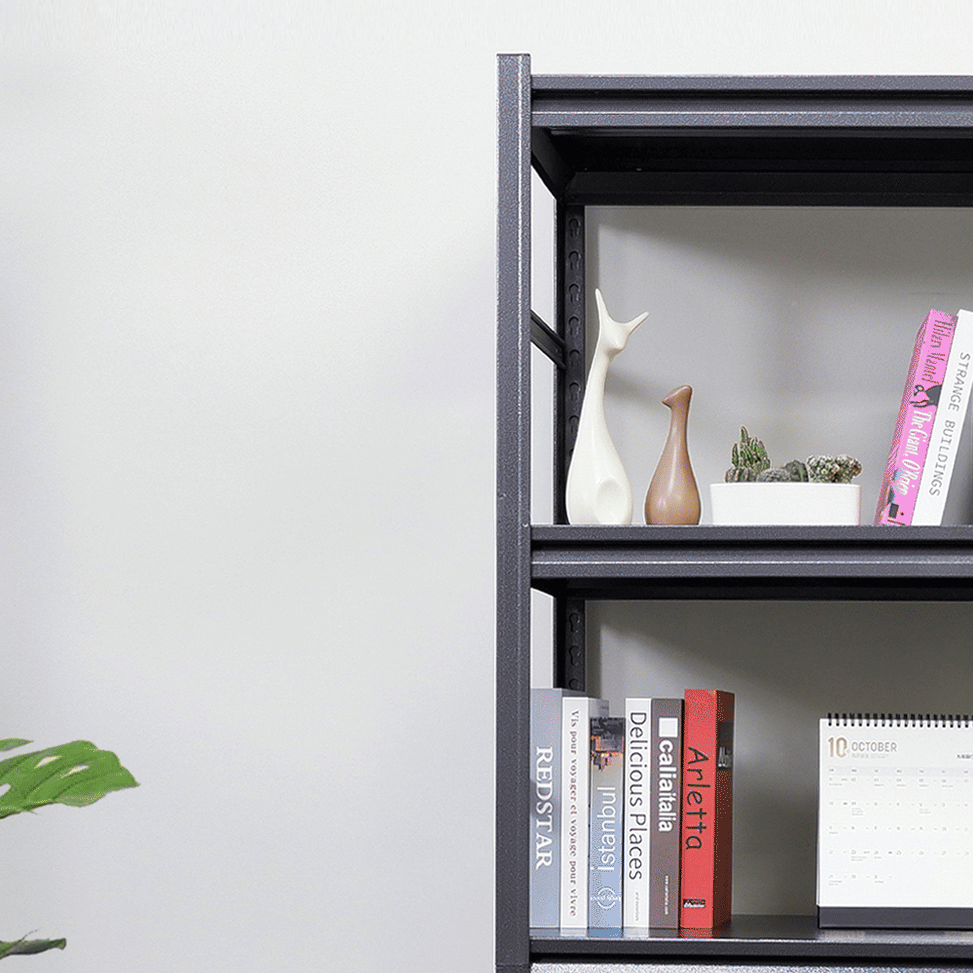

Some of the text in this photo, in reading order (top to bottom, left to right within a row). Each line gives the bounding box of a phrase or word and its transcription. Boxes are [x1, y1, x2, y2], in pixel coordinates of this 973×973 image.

[910, 410, 932, 428] The
[929, 352, 971, 496] STRANGE BUILDINGS
[658, 740, 676, 832] caliaitalia
[828, 737, 848, 758] 10
[851, 742, 898, 752] OCTOBER
[536, 746, 553, 870] REDSTAR
[569, 710, 579, 917] Vis pour voyager et voyage pour vivre
[597, 786, 616, 871] Istanbul
[629, 712, 647, 880] Delicious Places
[685, 747, 710, 850] Arletta
